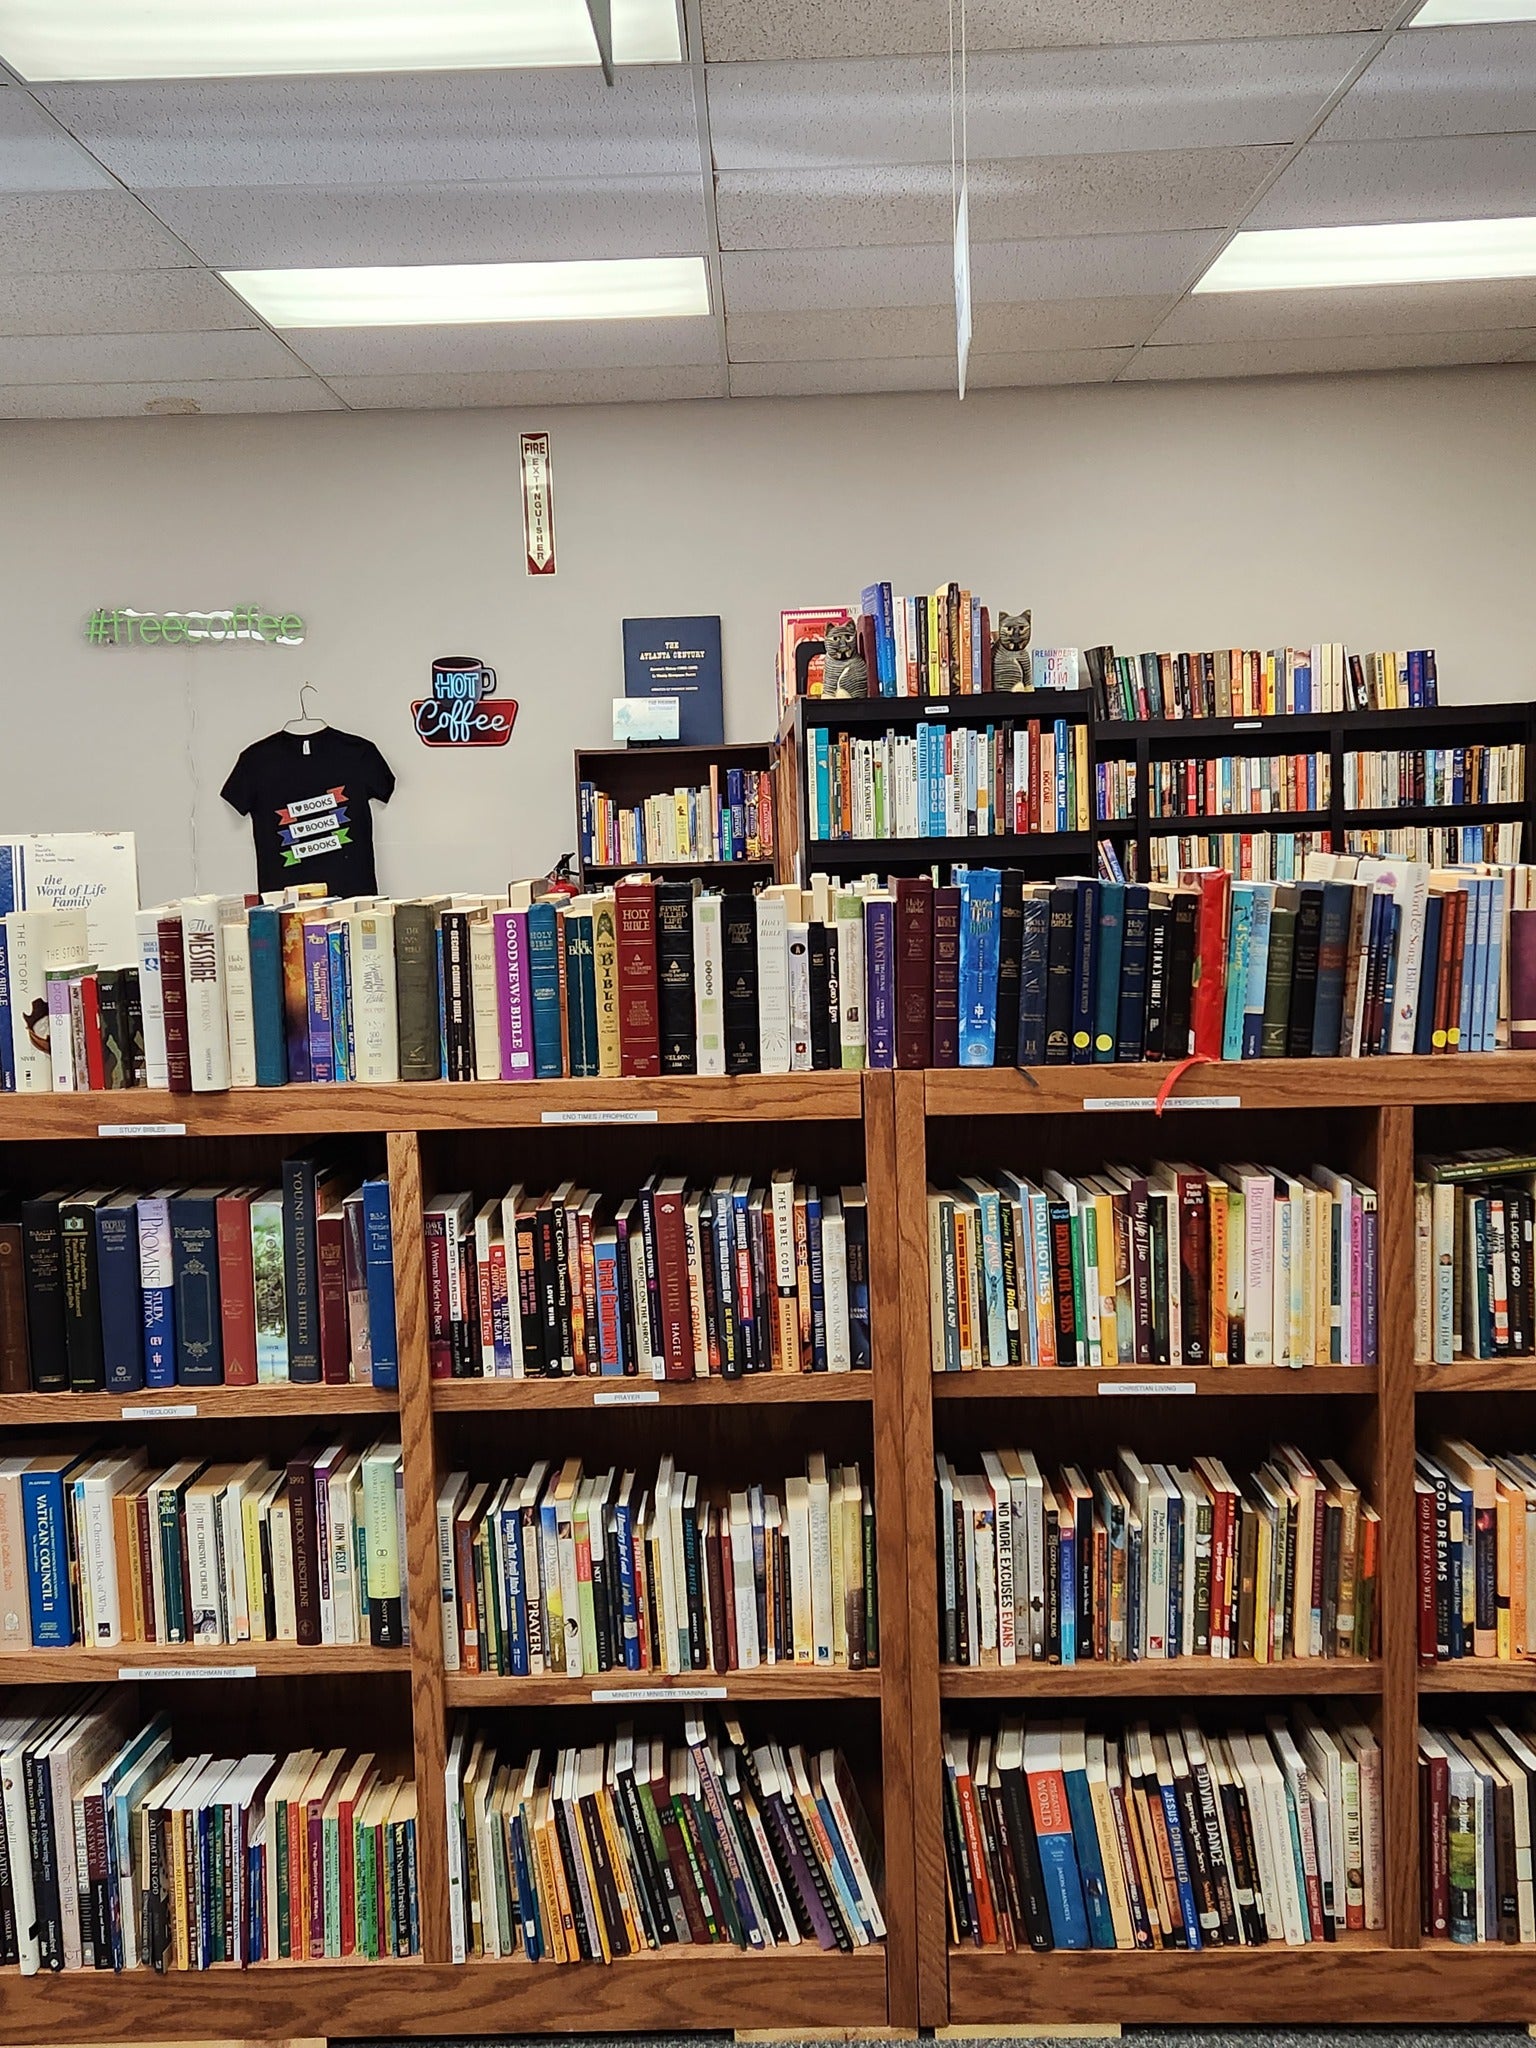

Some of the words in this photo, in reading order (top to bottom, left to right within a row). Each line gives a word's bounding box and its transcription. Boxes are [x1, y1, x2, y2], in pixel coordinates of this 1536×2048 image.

[525, 442, 545, 454] FIRE
[533, 458, 544, 560] EXTINGUISHER
[84, 603, 303, 644] #freecoffee
[640, 652, 671, 661] ATLANTA
[673, 651, 705, 659] CENTURY
[665, 641, 679, 650] THE
[1035, 649, 1076, 658] REMINDERS
[1048, 658, 1063, 671] OF
[435, 672, 478, 699] HOT
[1044, 672, 1068, 685] HIM
[416, 700, 511, 742] Coffee
[1058, 752, 1066, 776] HUNT
[1058, 778, 1066, 792] 'EM
[303, 797, 333, 812] BOOKS
[1058, 793, 1066, 808] UP!
[305, 818, 335, 832] BOOKS
[307, 838, 337, 852] BOOKS
[36, 885, 66, 896] Word
[69, 884, 81, 896] of
[84, 884, 107, 895] Life
[44, 874, 63, 886] the
[52, 896, 92, 908] Family
[1411, 882, 1425, 917] Word
[187, 919, 214, 932] The
[622, 909, 650, 920] HOLY
[622, 920, 651, 932] BIBLE
[1410, 918, 1424, 933] &
[16, 923, 25, 946] THE
[506, 919, 518, 961] GOOD
[1153, 925, 1165, 948] THE
[188, 932, 217, 983] MESSAGE
[1404, 934, 1420, 965] Song
[17, 954, 29, 994] STORY
[1152, 951, 1163, 976] HOLY
[508, 962, 520, 1004] NEWS
[1150, 980, 1162, 1008] BIBLE
[1404, 966, 1417, 998] Bible
[53, 983, 66, 1026] promise
[510, 1005, 522, 1049] BIBLE
[292, 1171, 304, 1221] YOUNG
[777, 1190, 786, 1210] THE
[1036, 1203, 1047, 1238] HOLY
[1250, 1187, 1264, 1245] BEAUTIFUL
[1510, 1201, 1518, 1220] THE
[779, 1216, 788, 1247] BIBLE
[1055, 1224, 1070, 1266] BEYOND
[1510, 1221, 1520, 1249] LOGIC
[141, 1217, 164, 1284] PROMISE
[431, 1241, 440, 1250] A
[1037, 1240, 1048, 1270] HOT
[1511, 1251, 1520, 1264] OF
[295, 1226, 306, 1296] READERS
[432, 1250, 440, 1278] Woman
[480, 1268, 490, 1277] If
[781, 1252, 790, 1280] CODE
[1250, 1248, 1264, 1288] WOMAN
[598, 1258, 616, 1292] Great
[1039, 1272, 1051, 1305] MESS
[1057, 1268, 1071, 1292] OUR
[1512, 1266, 1521, 1287] GOD
[433, 1280, 442, 1299] Rides
[480, 1278, 490, 1305] Grace
[144, 1291, 154, 1328] EDITION
[152, 1291, 164, 1322] STUDY
[433, 1300, 442, 1313] the
[482, 1309, 490, 1318] Is
[500, 1302, 510, 1318] THE
[1060, 1295, 1074, 1334] SELVES
[298, 1301, 308, 1345] BIBLE
[434, 1315, 443, 1336] Beast
[483, 1319, 491, 1340] True
[502, 1319, 512, 1346] ANGEL
[602, 1294, 620, 1365] Controversy
[671, 1322, 682, 1356] HAGEE
[998, 1502, 1009, 1517] NO
[1422, 1498, 1431, 1519] GOD
[1437, 1480, 1447, 1512] GOD
[36, 1494, 48, 1545] VATICAN
[196, 1517, 204, 1532] THE
[334, 1522, 346, 1541] JOHN
[1422, 1522, 1430, 1531] IS
[196, 1533, 206, 1569] CHRISTIAN
[999, 1521, 1010, 1554] MORE
[1422, 1533, 1431, 1562] ALIVE
[1437, 1519, 1448, 1582] DREAMS
[335, 1544, 348, 1574] WESLEY
[1198, 1561, 1208, 1584] The
[39, 1549, 51, 1600] COUNCIL
[199, 1570, 208, 1600] CHURCH
[593, 1566, 602, 1584] NOT
[1000, 1558, 1012, 1608] EXCUSES
[1423, 1564, 1432, 1584] AND
[42, 1601, 53, 1612] II
[381, 1600, 390, 1623] SCOTT
[1198, 1586, 1210, 1612] Call
[1424, 1586, 1432, 1612] WELL
[528, 1601, 542, 1654] PRAYER
[1002, 1611, 1014, 1648] EVANS
[85, 1802, 94, 1815] AN
[95, 1800, 103, 1812] TO
[1036, 1779, 1052, 1827] WORLD
[1049, 1779, 1061, 1826] OPERATION
[1197, 1775, 1214, 1818] DIVINE
[75, 1803, 85, 1828] THIS
[149, 1818, 157, 1832] ALL
[76, 1829, 86, 1846] WE
[87, 1818, 97, 1865] ANSWER
[96, 1817, 107, 1876] EVERYONE
[1204, 1822, 1224, 1868] DANCE
[77, 1848, 88, 1889] BELIEVE
[151, 1863, 159, 1874] IN
[1056, 1867, 1068, 1887] JASON
[151, 1876, 160, 1895] GOD
[1030, 1896, 1038, 1915] PIPER
[1061, 1889, 1071, 1922] MANDRYK
[4, 1909, 13, 1941] MISSLER
